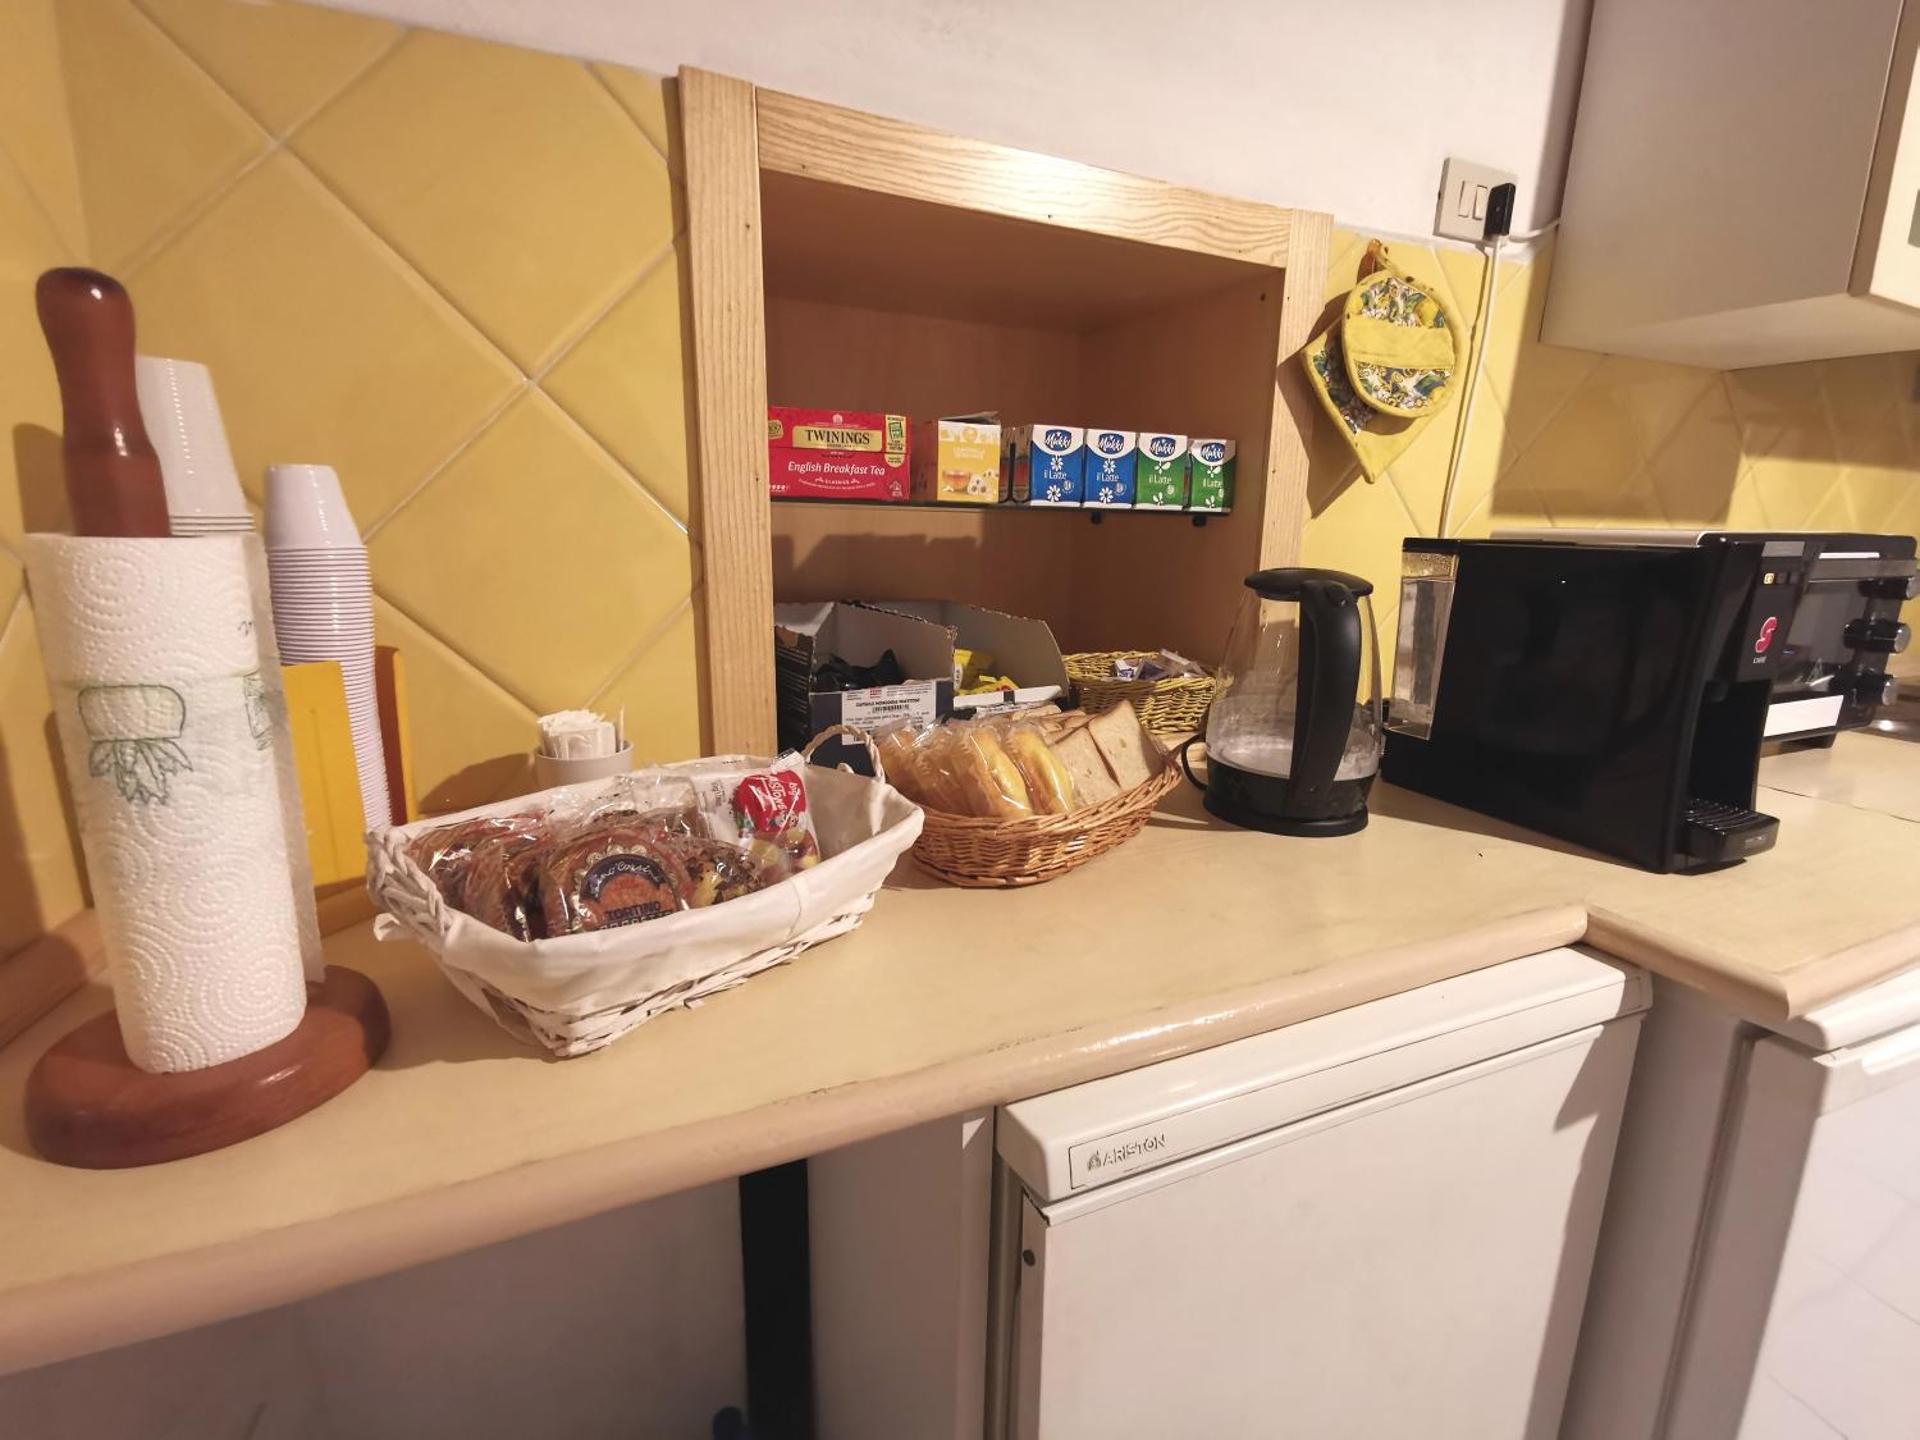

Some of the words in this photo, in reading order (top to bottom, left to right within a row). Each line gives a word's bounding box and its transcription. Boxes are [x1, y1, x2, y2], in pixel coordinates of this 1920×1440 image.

[805, 429, 870, 445] TWININGS
[788, 461, 821, 474] English
[823, 463, 868, 477] Breakfast
[870, 465, 886, 476] Tea
[1102, 1133, 1166, 1167] ARISTON
